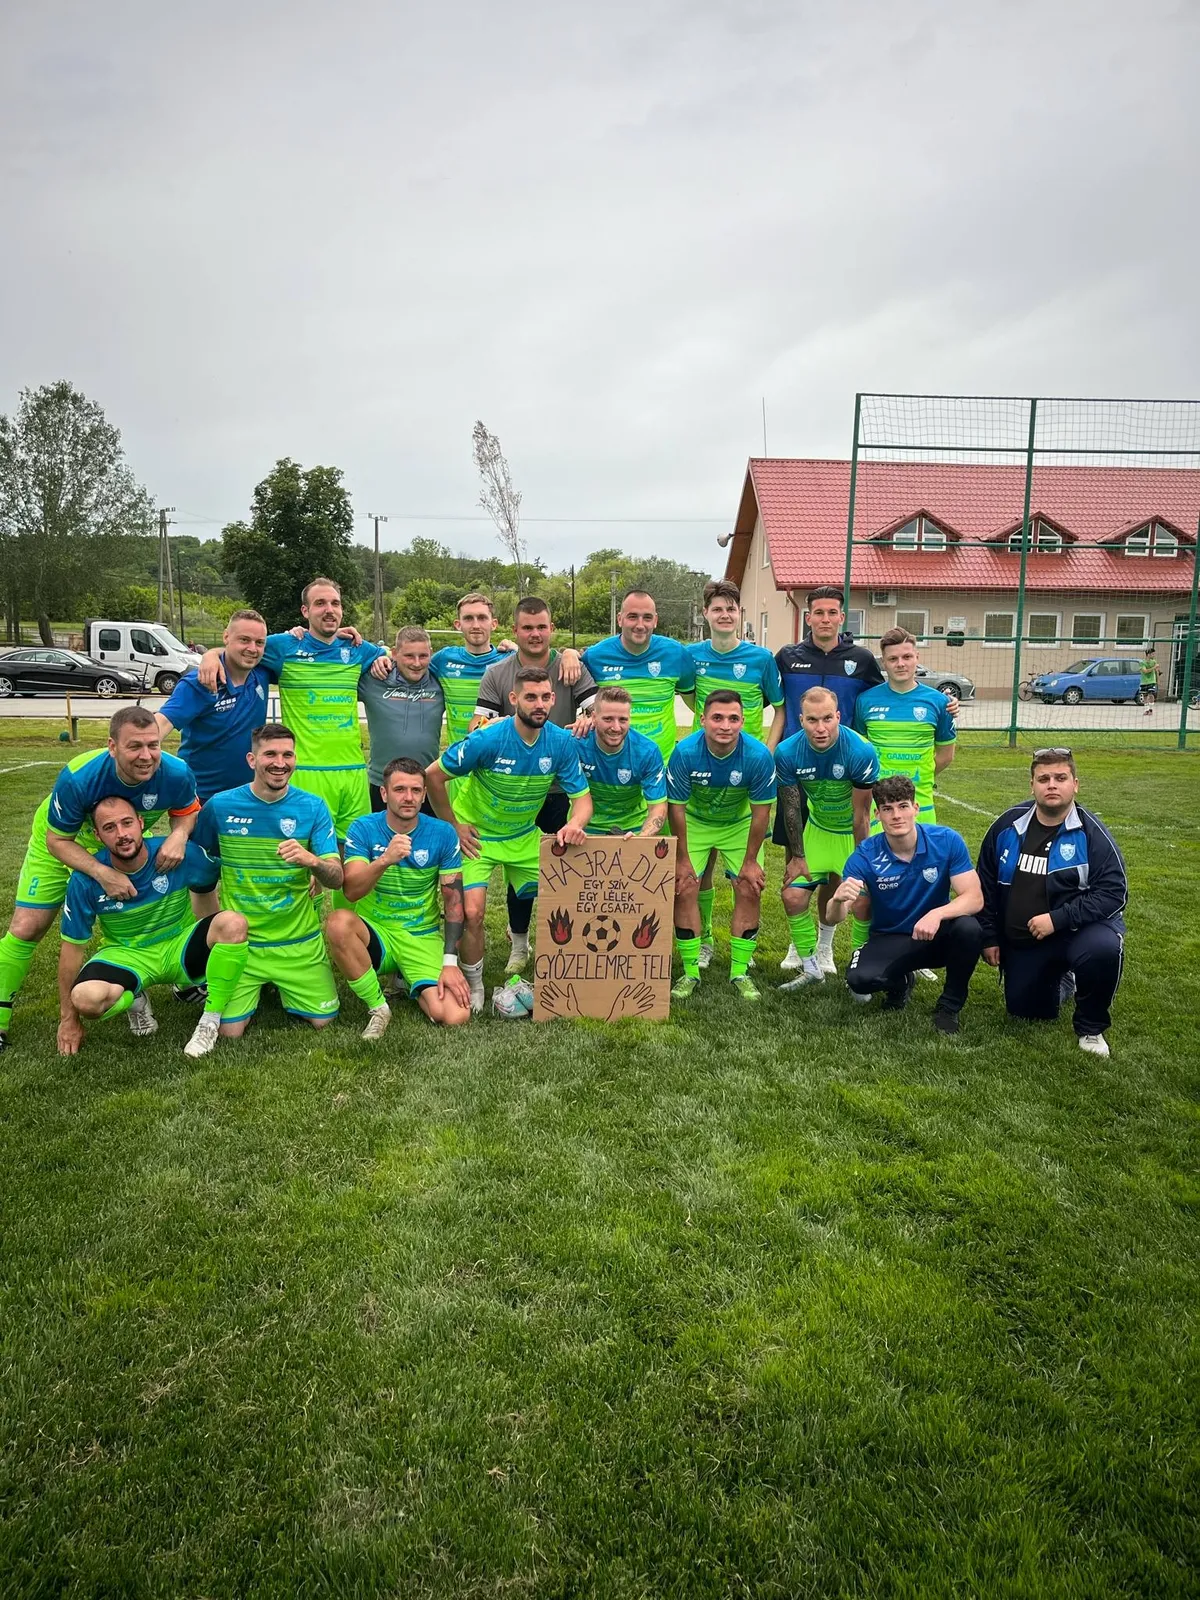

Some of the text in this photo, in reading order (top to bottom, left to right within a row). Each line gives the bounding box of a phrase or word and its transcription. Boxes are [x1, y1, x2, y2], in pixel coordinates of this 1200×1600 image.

[495, 757, 516, 766] Zeus
[580, 762, 596, 771] eus
[796, 767, 816, 775] Zeus
[226, 815, 253, 824] Zeus
[373, 844, 388, 853] Ze
[1018, 853, 1048, 875] UM
[541, 848, 675, 902] HAJRÁ DLK
[876, 875, 901, 883] Zeus
[584, 878, 630, 890] EGY SZÍV
[579, 890, 635, 902] EGY LÉLEK
[577, 902, 645, 914] EGY CSAPAT
[535, 949, 637, 980] GYŐZELEMRE
